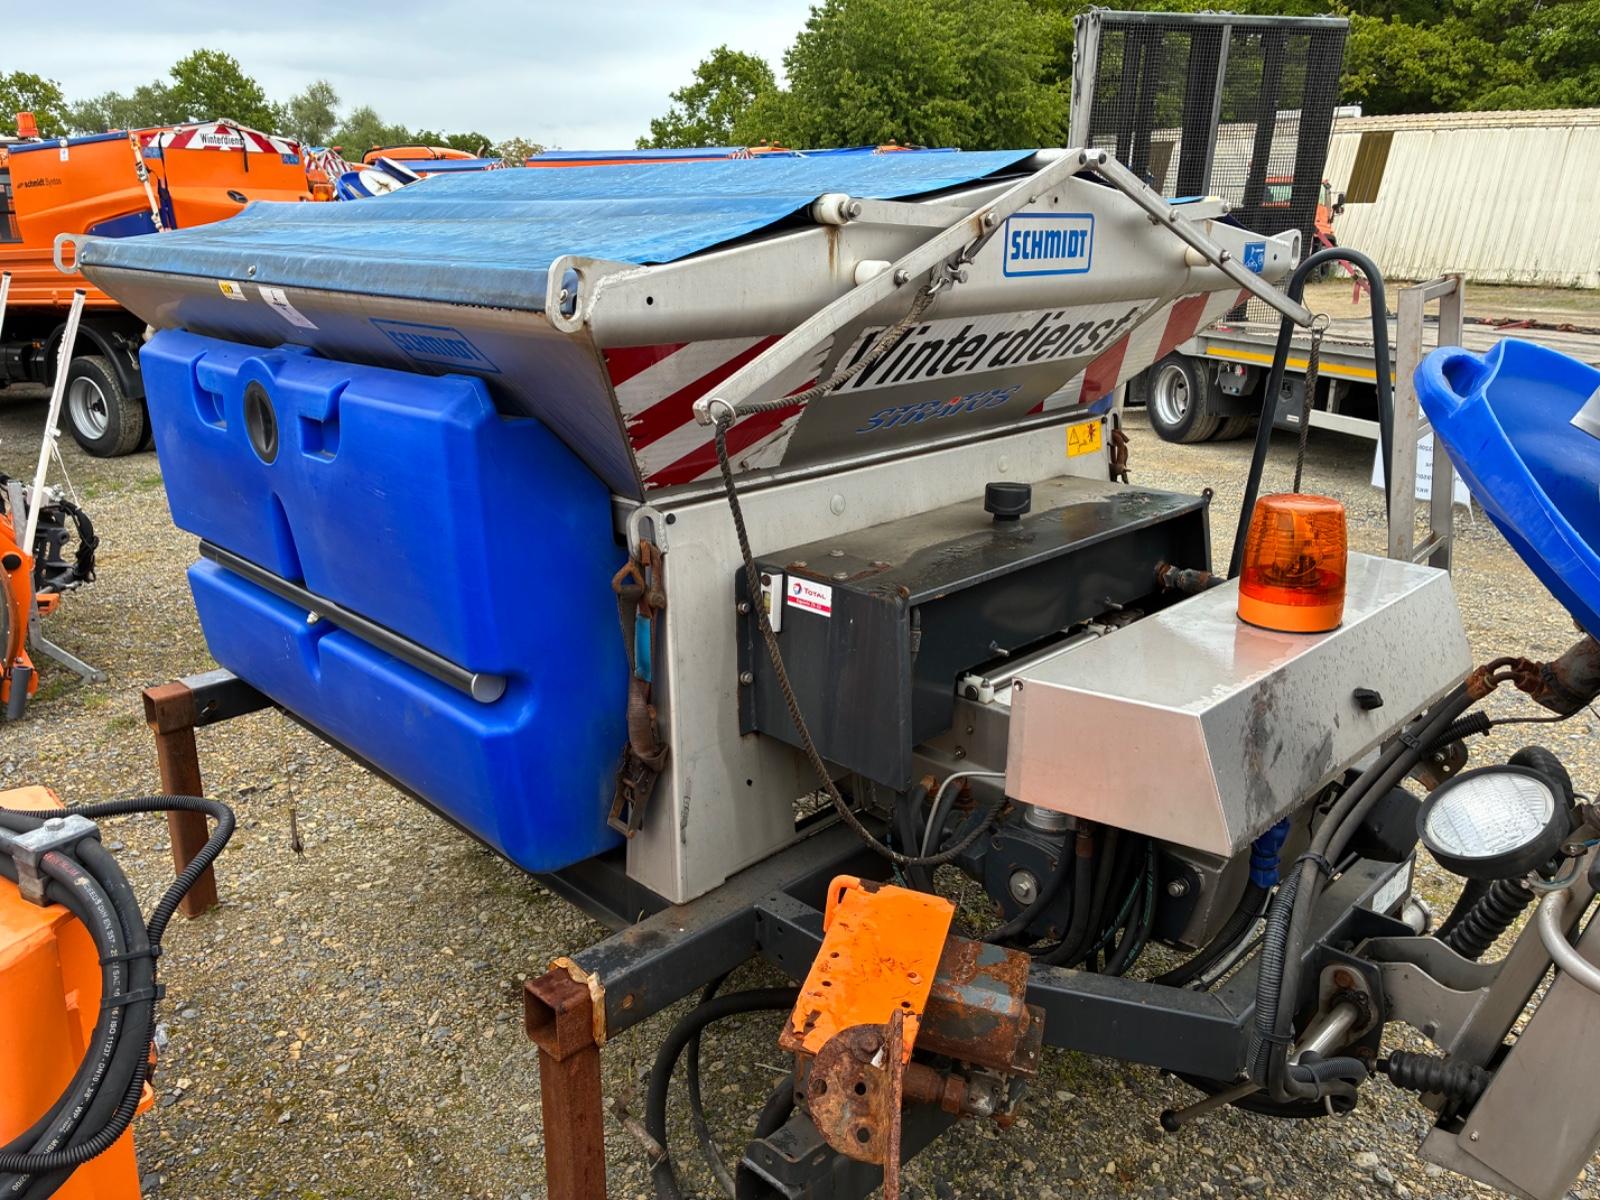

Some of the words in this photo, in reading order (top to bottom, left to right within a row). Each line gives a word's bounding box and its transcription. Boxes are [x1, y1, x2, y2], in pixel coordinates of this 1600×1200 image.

[1011, 227, 1089, 260] SCHMIDT
[388, 330, 482, 361] SCHMIDT
[832, 306, 1139, 391] Winterdienst
[856, 384, 1024, 434] STRATOS
[109, 1022, 118, 1035] ISO
[103, 1036, 114, 1058] 11237
[72, 1105, 84, 1119] WP
